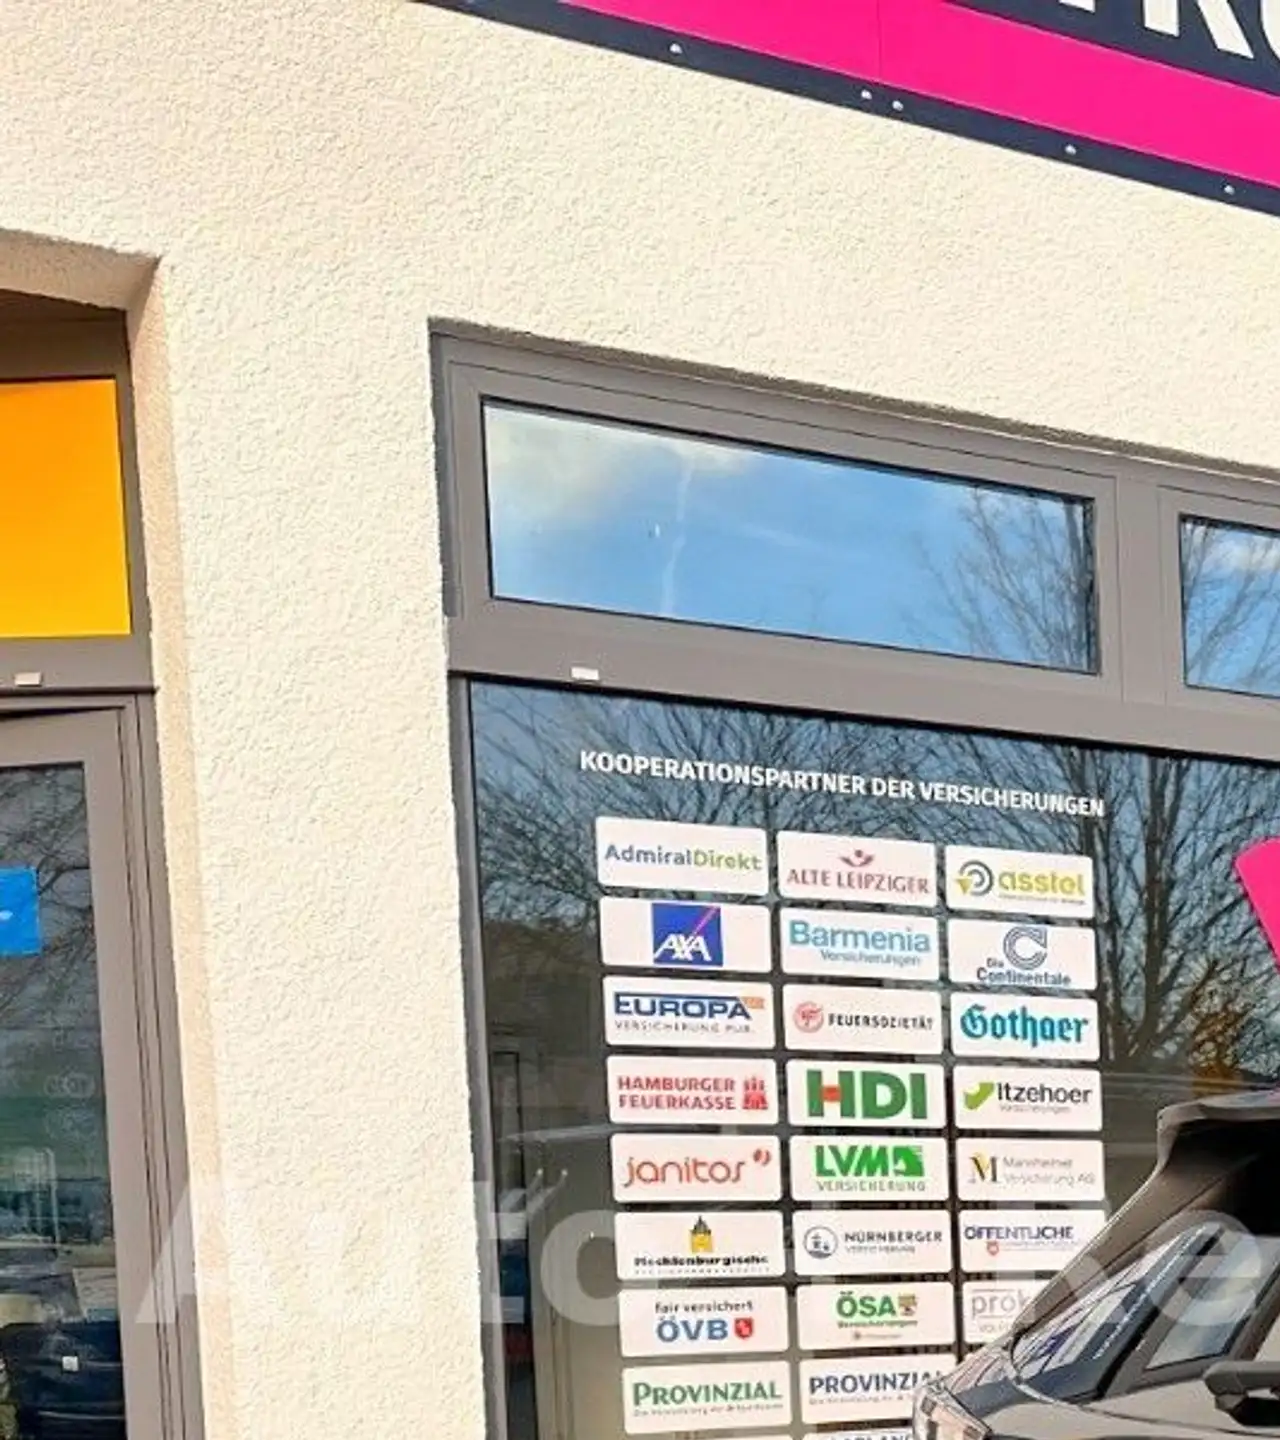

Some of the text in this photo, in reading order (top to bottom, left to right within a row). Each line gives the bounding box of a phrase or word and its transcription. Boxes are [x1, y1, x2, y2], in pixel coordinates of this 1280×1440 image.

[579, 750, 1105, 817] KOOPERATIONSPARTNER DER VERSICHERUNGEN
[604, 845, 762, 871] AdmiralDirekt
[786, 868, 928, 894] ALTE LEIPZIGER
[999, 870, 1085, 896] asstel
[653, 933, 712, 962] AXA
[789, 920, 930, 953] Barmenia
[977, 967, 1071, 986] Continentale
[613, 992, 752, 1020] EUROPA
[828, 1013, 933, 1030] FEUERSOZIETÄT
[960, 1003, 1089, 1048] Gothaer
[617, 1075, 735, 1091] HAMBURGER
[806, 1069, 928, 1119] HDI
[997, 1082, 1092, 1103] Itzehoer
[618, 1095, 736, 1110] FEUERKASSE
[623, 1155, 746, 1187] janitos
[815, 1145, 888, 1177] LVM
[845, 1229, 942, 1242] NÜRNBERGER
[655, 1300, 752, 1313] fair versichert
[836, 1291, 896, 1318] ÖSA
[657, 1316, 728, 1342] ÖVB
[633, 1381, 782, 1406] PROVINZIAL
[809, 1371, 939, 1394] PROVINZI
